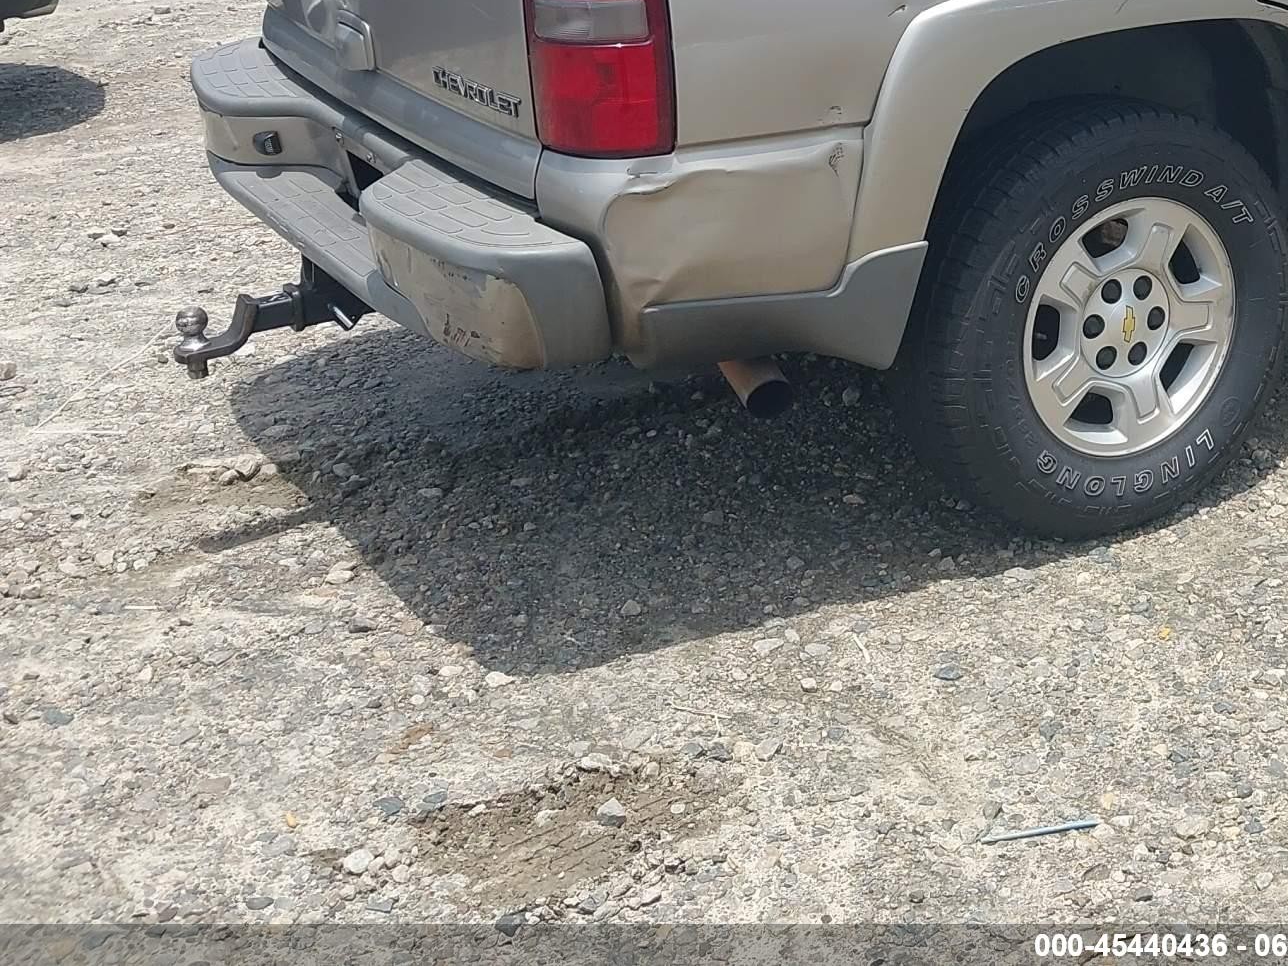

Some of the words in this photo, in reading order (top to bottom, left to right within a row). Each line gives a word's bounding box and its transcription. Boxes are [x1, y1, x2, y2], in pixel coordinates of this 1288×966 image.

[431, 66, 522, 118] CHEVROLET
[1015, 165, 1204, 304] CROSSWIND
[1204, 185, 1254, 224] A/T
[1036, 428, 1215, 497] LINGLONG
